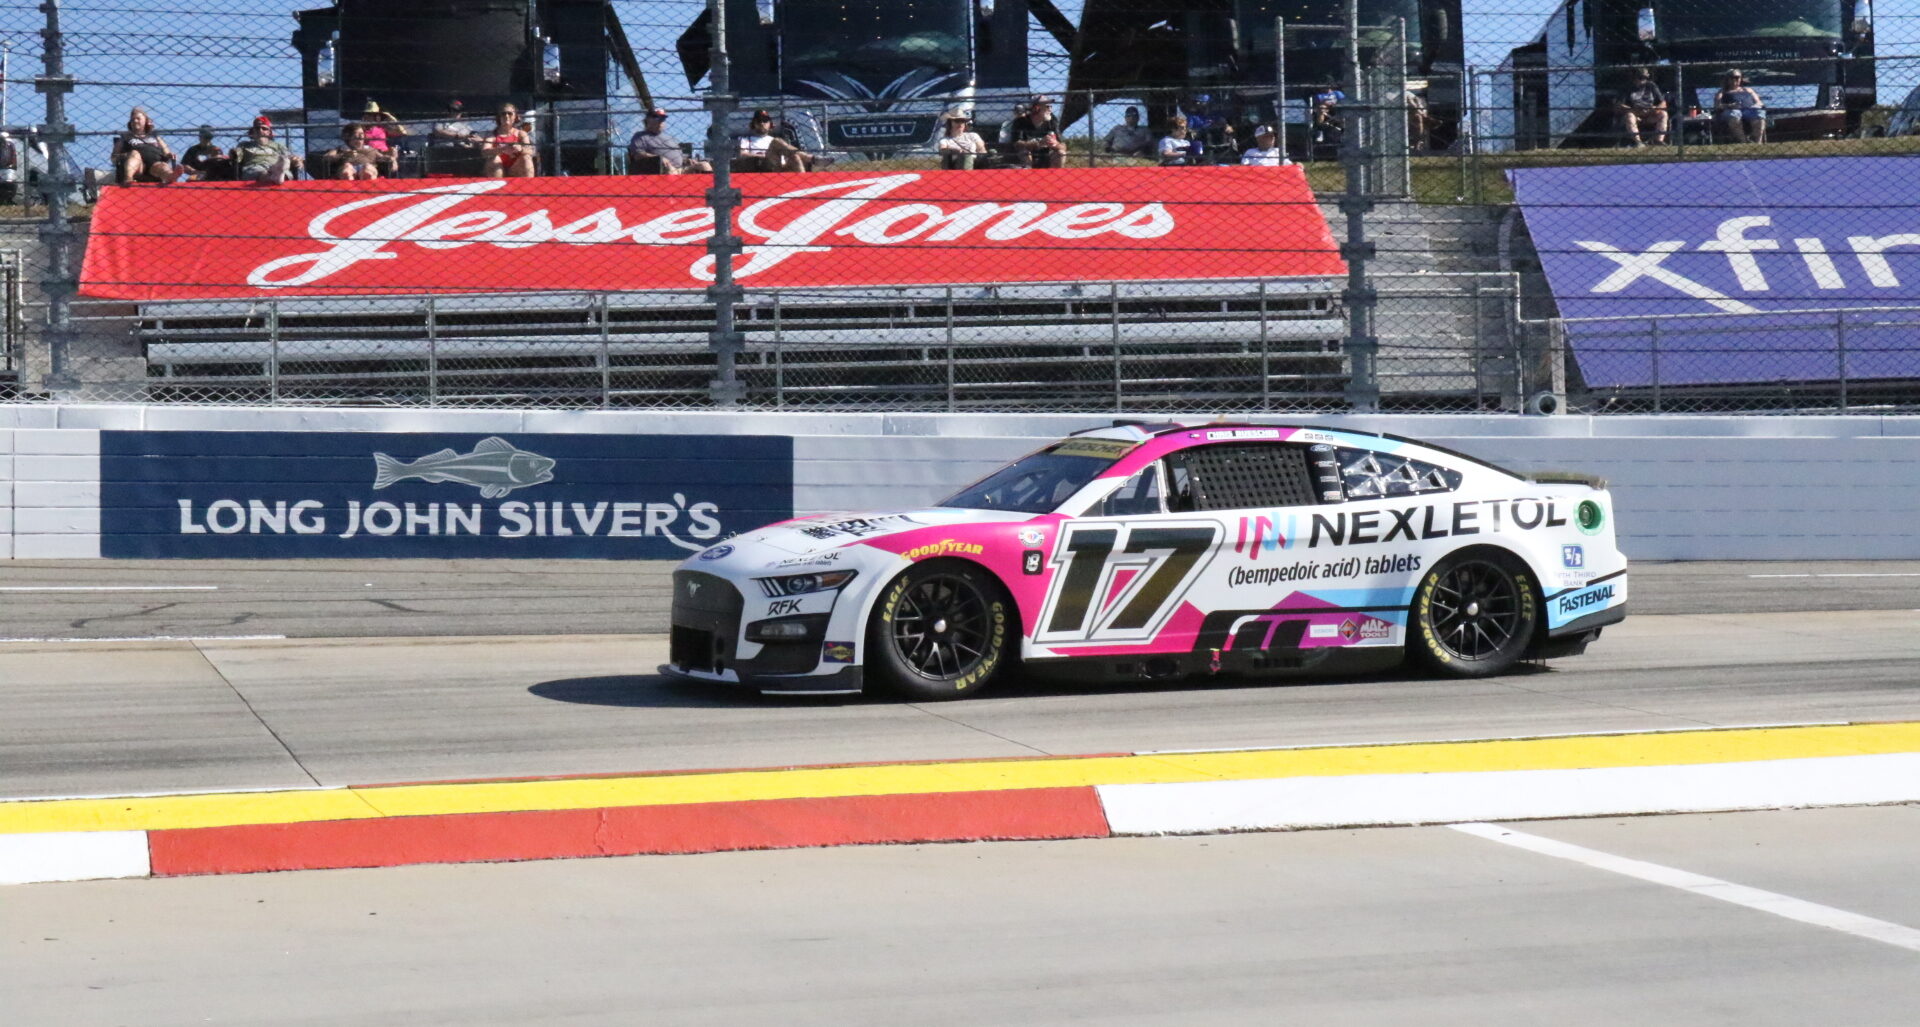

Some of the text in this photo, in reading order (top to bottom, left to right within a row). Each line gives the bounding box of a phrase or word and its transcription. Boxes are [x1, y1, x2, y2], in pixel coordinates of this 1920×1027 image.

[247, 174, 1175, 289] Jesse Jones
[178, 493, 721, 549] LONG JOHN SILVER'S
[1309, 496, 1567, 548] NEXLETOL
[900, 539, 984, 561] GOODYEAR
[1228, 553, 1421, 588] (bempedoic acid) tablets
[883, 575, 910, 622] EAGLE
[1040, 522, 1221, 641] 17
[1515, 574, 1533, 621] EAGLE
[1560, 585, 1615, 615] FASTENAL
[768, 599, 803, 616] RFK
[1420, 572, 1451, 663] GOODYEAR
[955, 602, 1005, 690] GOODYEAR
